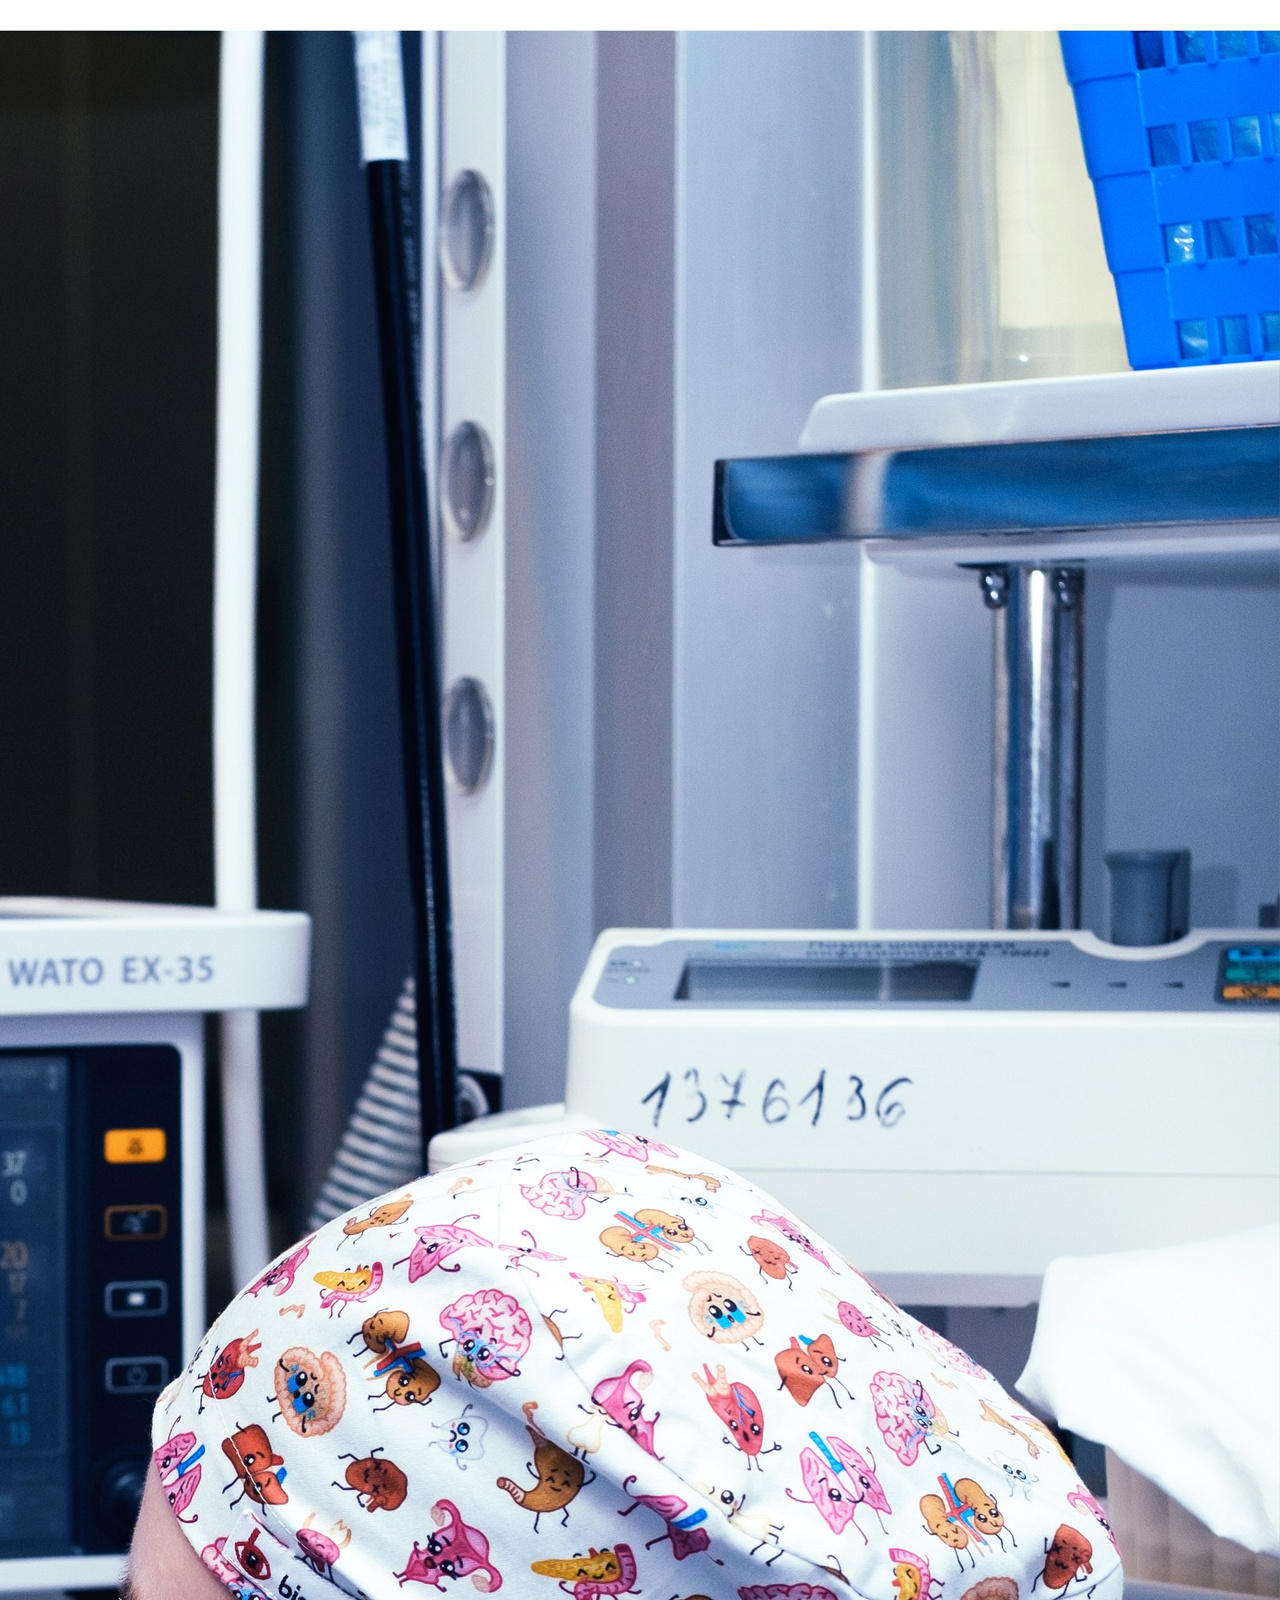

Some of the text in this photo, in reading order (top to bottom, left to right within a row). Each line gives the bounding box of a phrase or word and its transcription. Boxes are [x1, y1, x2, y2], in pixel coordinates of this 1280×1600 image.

[8, 953, 214, 987] WATO EX-35
[640, 1067, 914, 1128] 1376136
[1, 1151, 26, 1177] 37
[9, 1179, 28, 1207] 0
